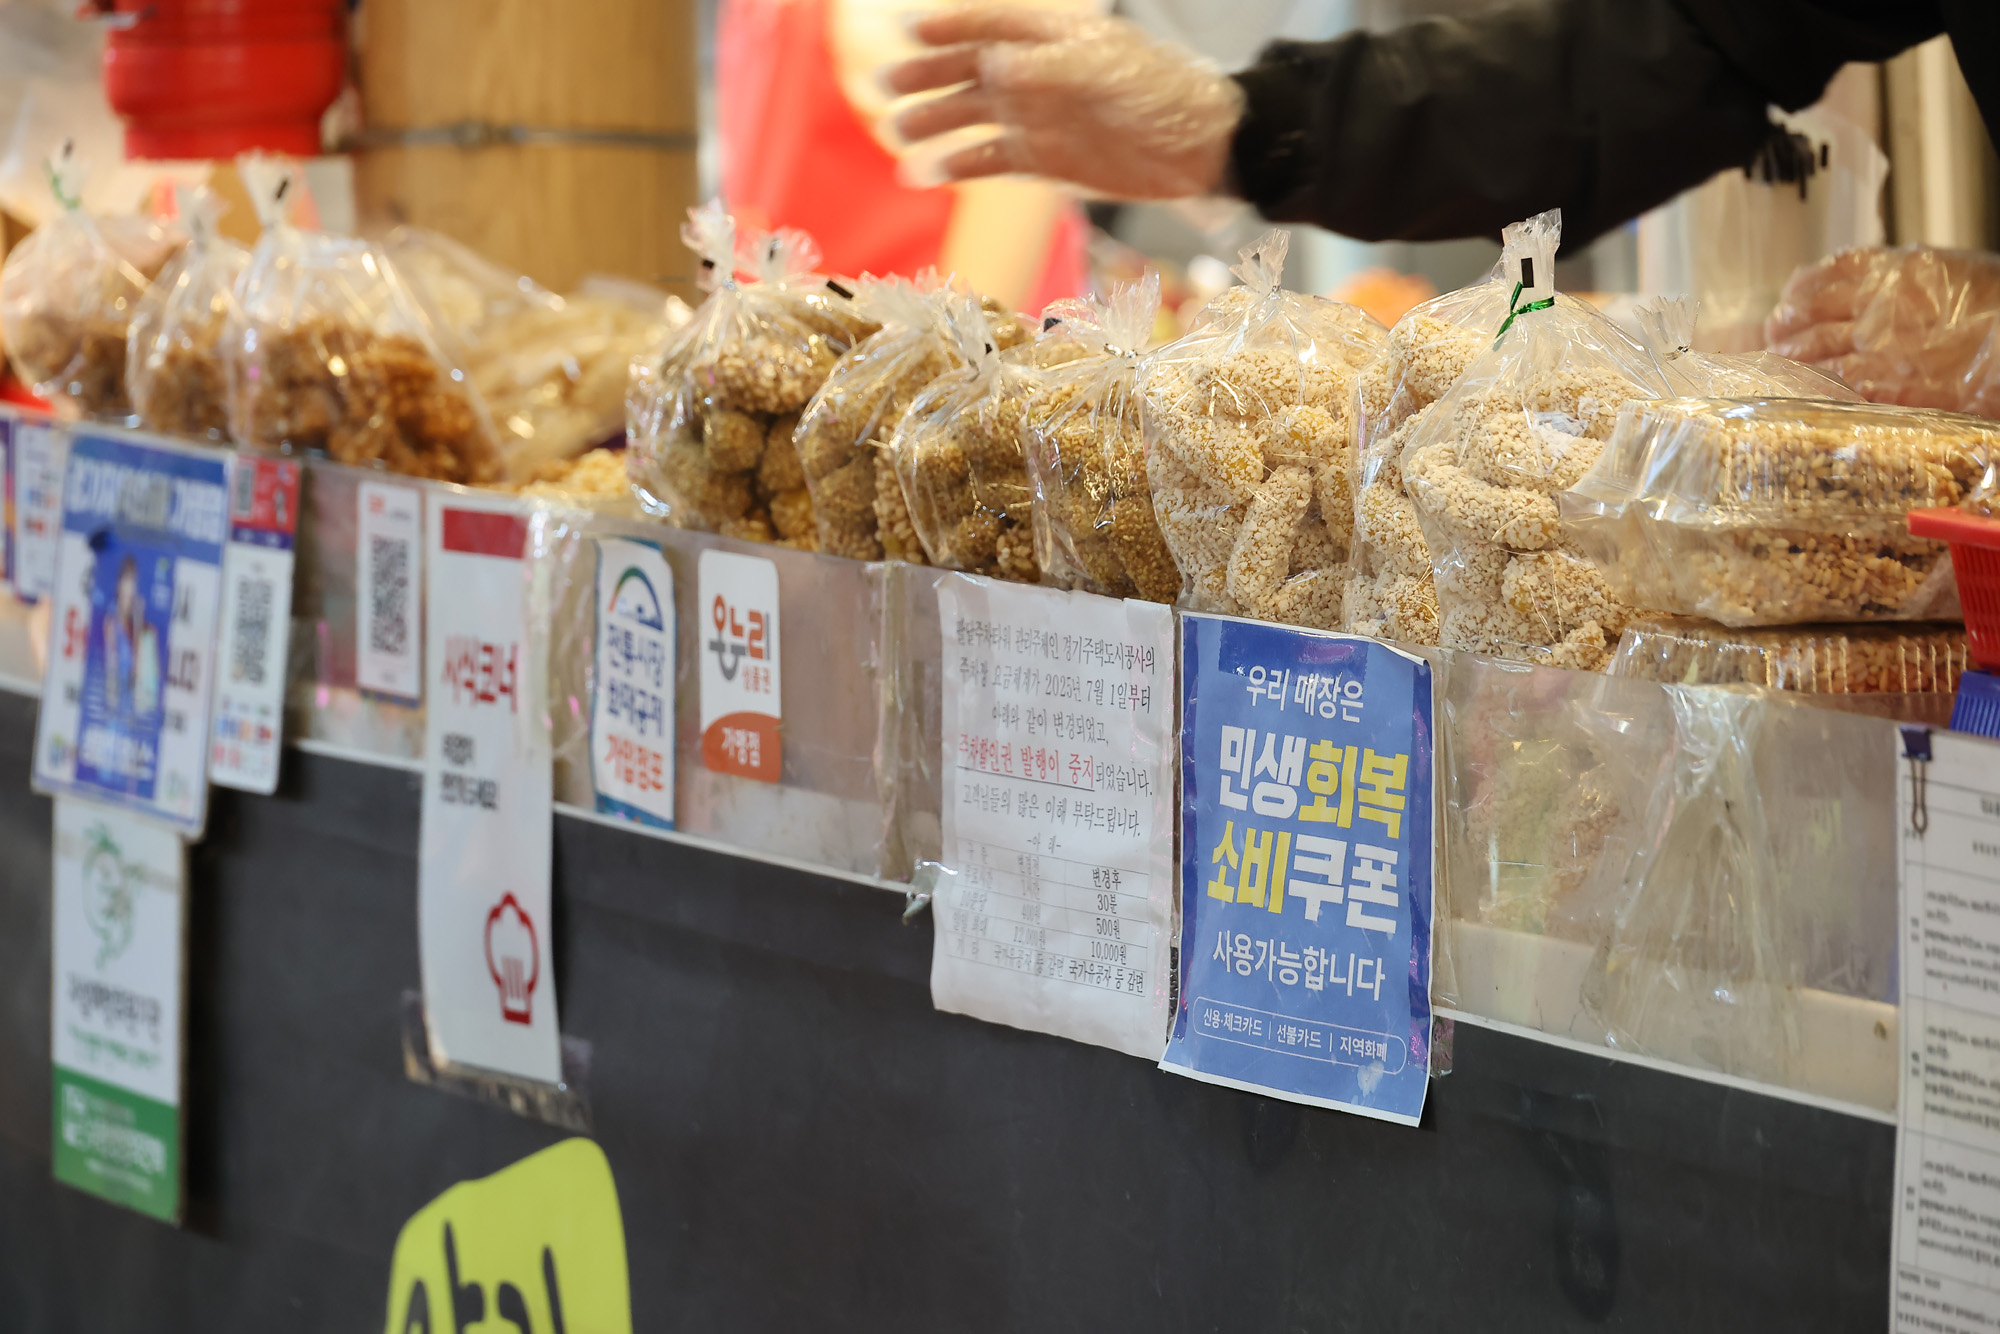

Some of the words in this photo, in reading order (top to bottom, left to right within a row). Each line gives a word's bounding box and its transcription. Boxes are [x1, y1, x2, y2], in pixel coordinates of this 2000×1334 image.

[1063, 635, 1155, 675] 경기주택도시공사의
[1045, 673, 1082, 702] 2025년
[1086, 679, 1105, 706] 7월
[1110, 682, 1151, 714] 1일부터
[1246, 665, 1290, 712] 우리
[1294, 671, 1364, 723] 매장은
[1026, 707, 1048, 737] 같이
[1053, 711, 1109, 746] 변경되었고,
[721, 727, 761, 767] 가맹점
[1020, 745, 1060, 783] 발행이
[1219, 724, 1409, 839] 민생회복
[1045, 795, 1067, 825] 이해
[1072, 800, 1141, 838] 부탁드립니다.
[1092, 867, 1122, 891] 변경후
[1207, 820, 1398, 934] 소비쿠폰
[1097, 893, 1117, 915] 30분
[1096, 917, 1121, 940] 500원
[1091, 940, 1127, 966] 10,000원
[1212, 929, 1386, 1001] 사용가능합니다
[1069, 960, 1112, 987] 국가유공자
[1114, 968, 1124, 990] 등
[1127, 970, 1144, 994] 감면
[1276, 1023, 1322, 1049] 선불카드
[1339, 1035, 1388, 1062] 지역화폐
